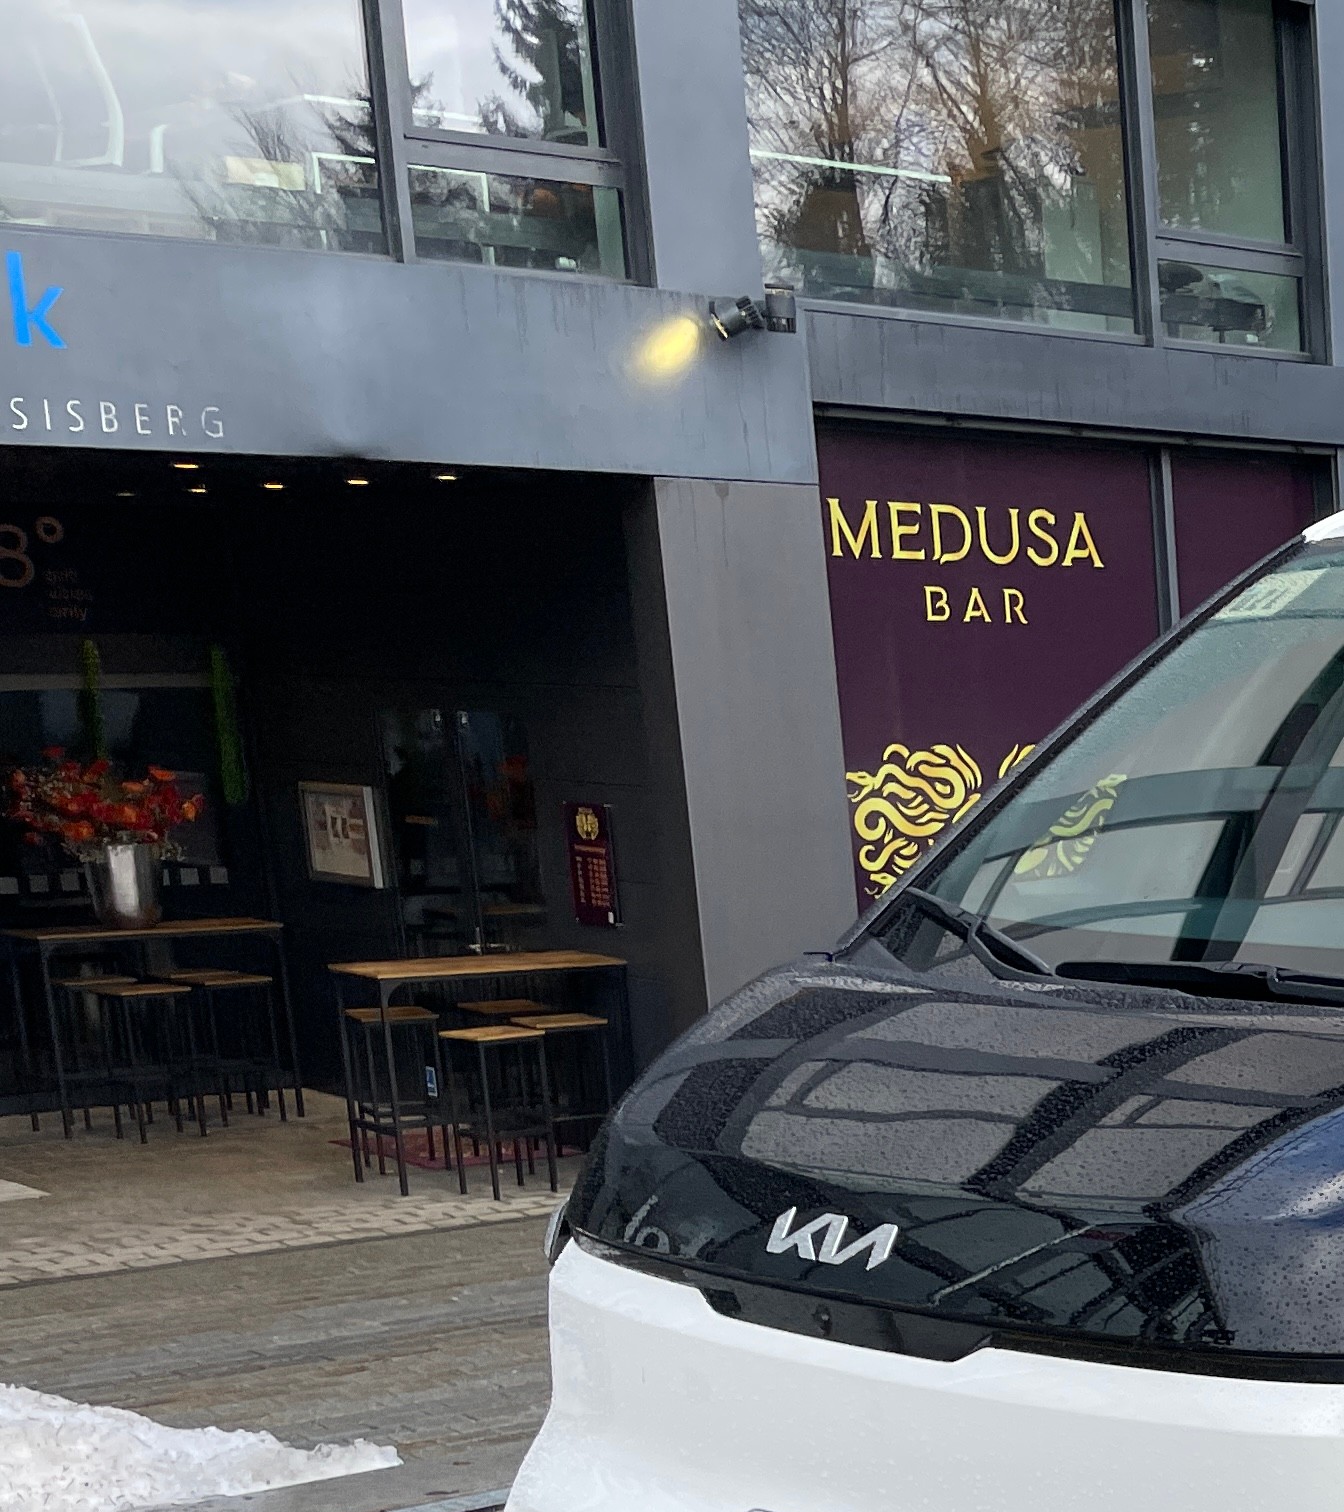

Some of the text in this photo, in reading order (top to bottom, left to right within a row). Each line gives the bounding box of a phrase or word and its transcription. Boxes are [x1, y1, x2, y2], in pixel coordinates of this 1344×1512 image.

[9, 397, 225, 439] SISBERG
[826, 497, 1105, 568] MEDUSA
[924, 585, 1029, 625] BAR
